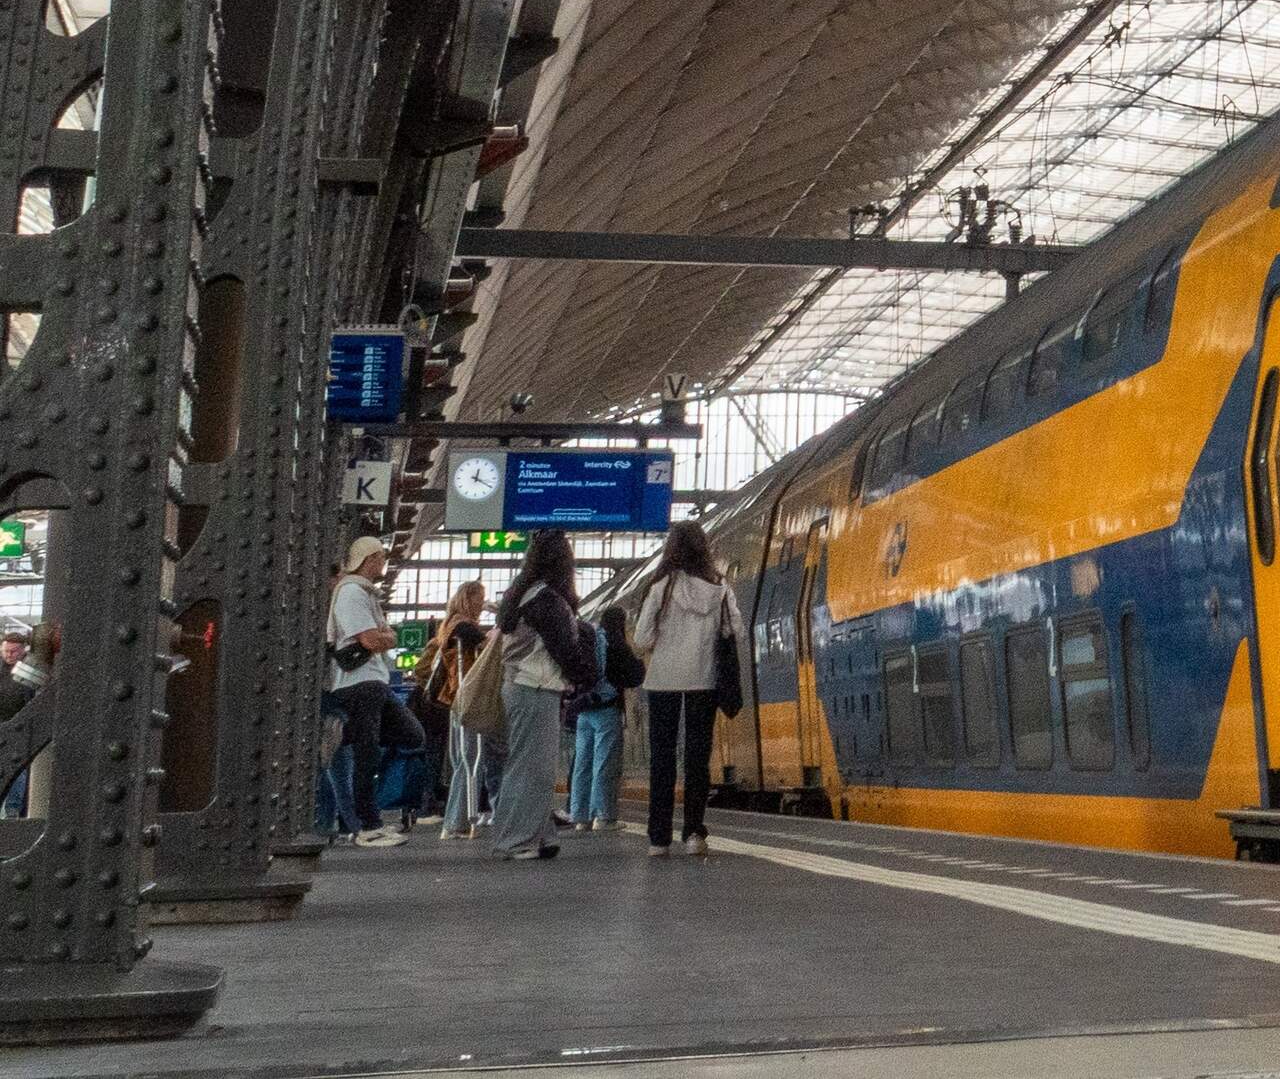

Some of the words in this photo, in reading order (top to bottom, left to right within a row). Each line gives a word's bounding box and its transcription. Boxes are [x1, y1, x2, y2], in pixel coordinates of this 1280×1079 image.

[667, 375, 686, 399] V
[584, 461, 613, 469] Intercity
[518, 469, 558, 479] Alkmaar
[356, 477, 376, 500] K
